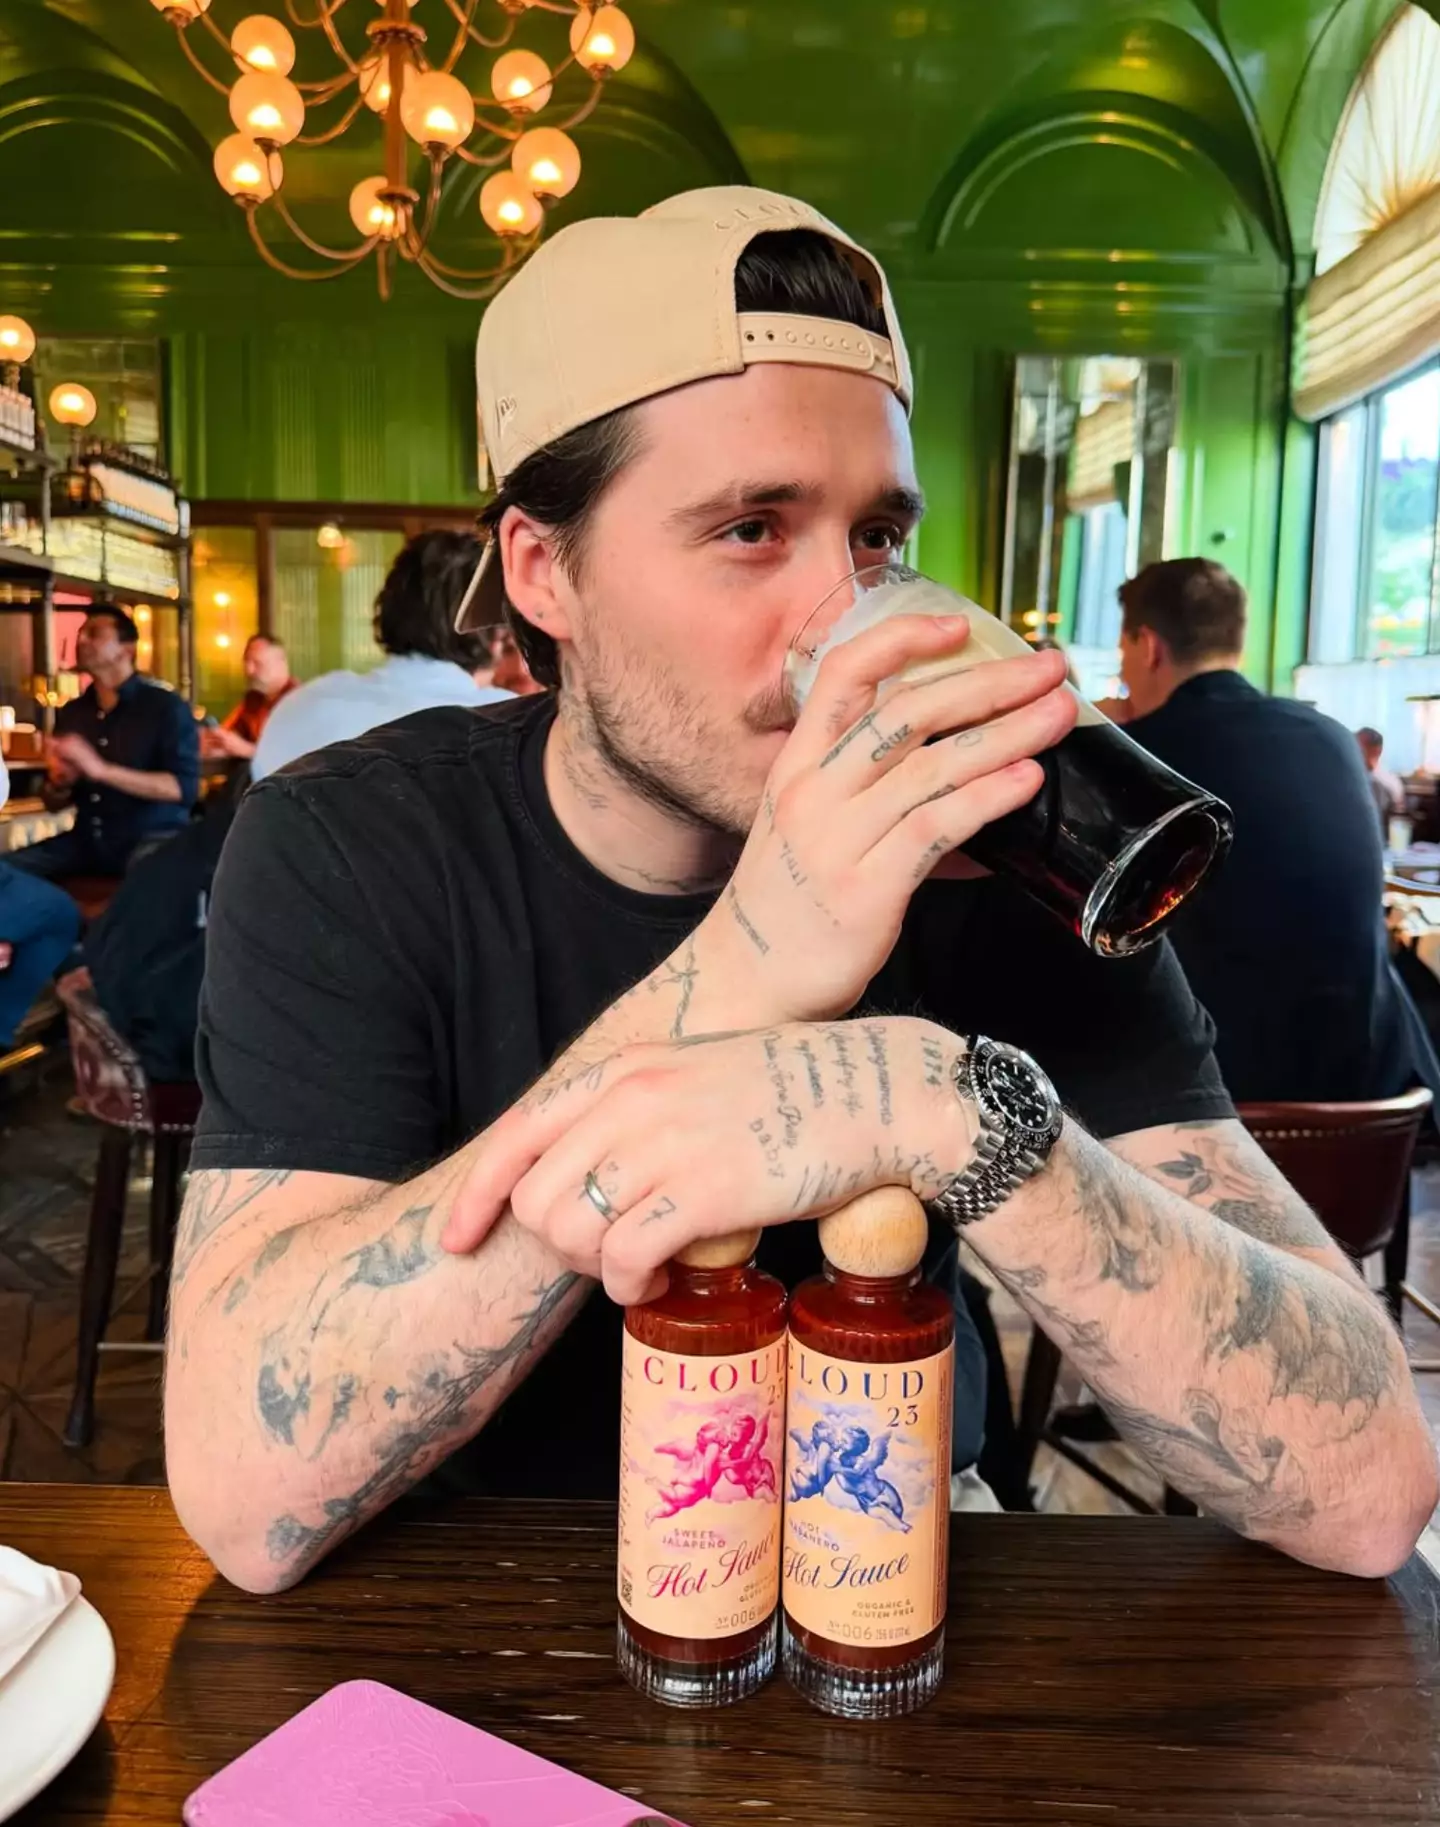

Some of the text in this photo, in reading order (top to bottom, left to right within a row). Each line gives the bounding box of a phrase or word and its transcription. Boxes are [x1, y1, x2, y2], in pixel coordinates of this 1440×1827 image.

[886, 1404, 919, 1428] 23
[783, 1546, 822, 1589] Hot
[824, 1552, 910, 1590] Sauce
[646, 1562, 708, 1599] Hot
[851, 1609, 891, 1620] GLUTEN
[856, 1601, 903, 1610] ORGANIC
[842, 1623, 873, 1640] 006
